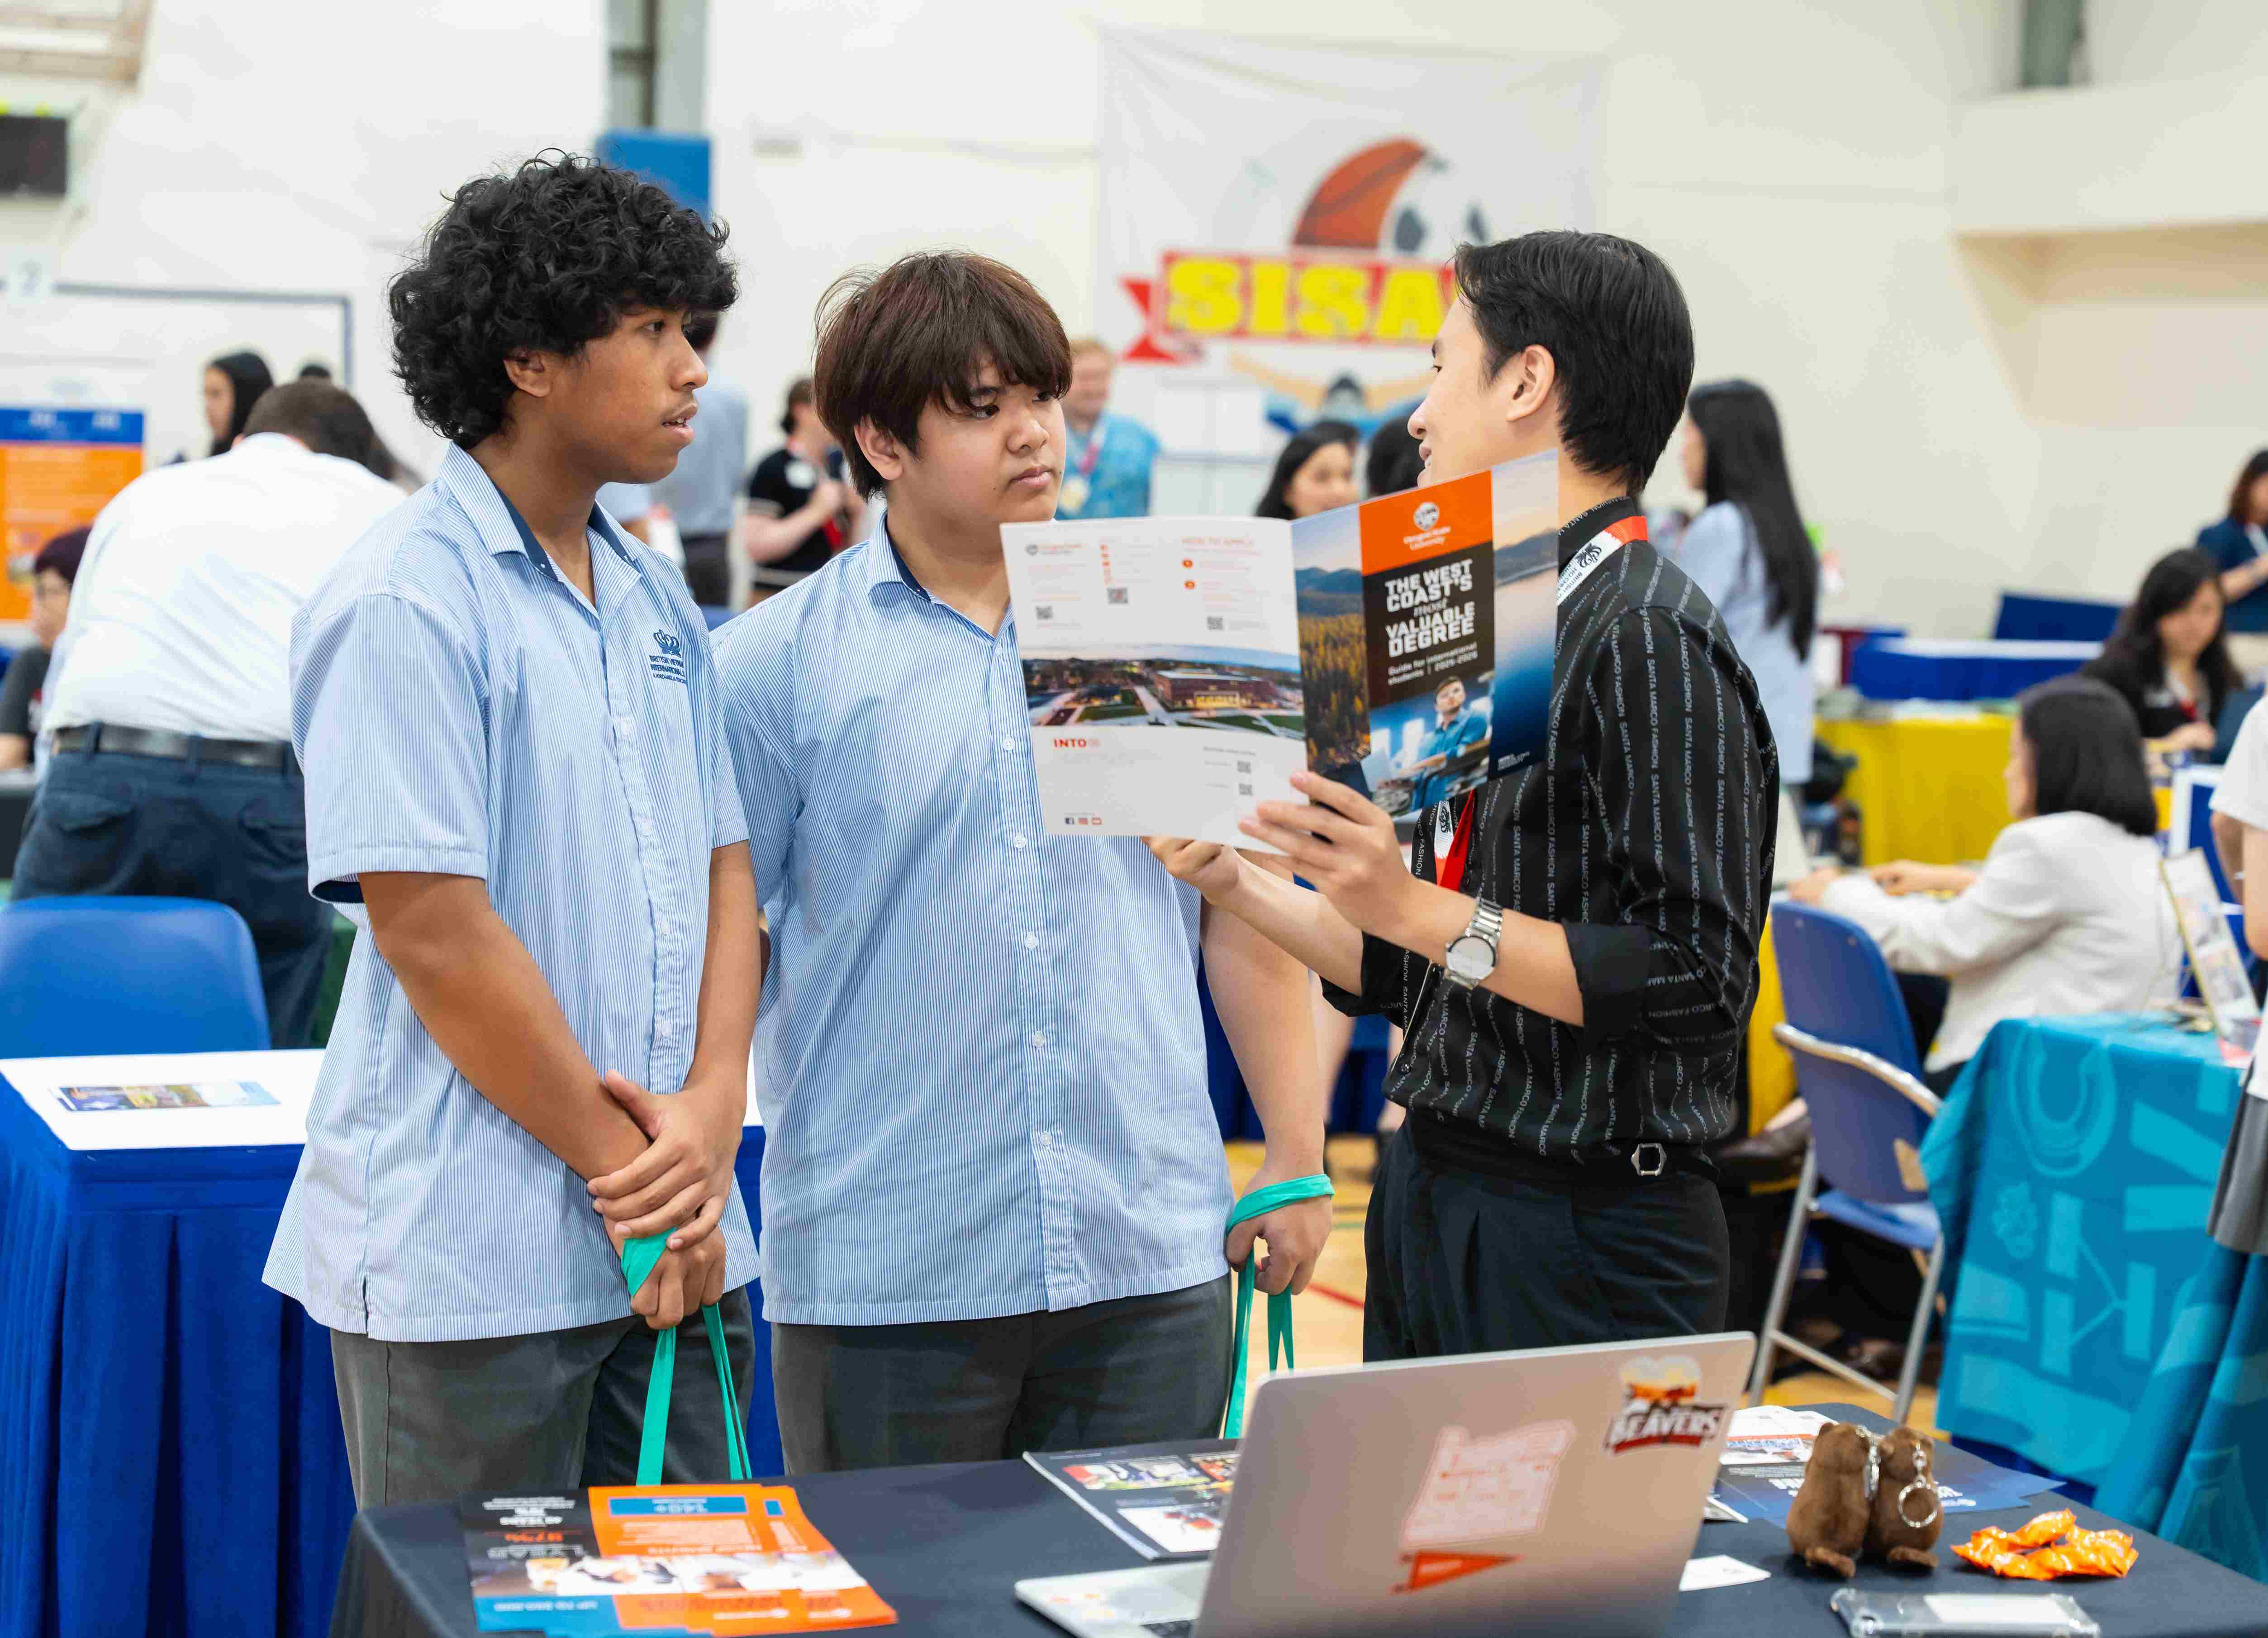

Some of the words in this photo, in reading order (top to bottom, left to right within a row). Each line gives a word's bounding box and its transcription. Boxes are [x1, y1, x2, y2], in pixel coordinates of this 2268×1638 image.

[1166, 256, 1459, 343] SISA
[1385, 573, 1420, 596] THE
[1423, 558, 1473, 584] WEST
[1386, 572, 1474, 612] COAST'S
[1385, 601, 1475, 639] VALUABLE
[1413, 598, 1448, 618] most
[1388, 617, 1474, 657] DEGREE
[1643, 617, 1655, 654] FASHION
[1679, 636, 1690, 670] MARCO
[1388, 661, 1412, 676] Guide
[1646, 659, 1657, 689] SANTA
[1615, 675, 1625, 717] FASHION
[1650, 690, 1658, 726] MARCO
[1683, 671, 1692, 712] FASHION
[1684, 716, 1693, 748] SANTA
[1716, 697, 1725, 732] MARCO
[1053, 738, 1087, 748] INTO
[1620, 722, 1631, 753] SANTA
[1650, 727, 1659, 769] FASHION
[1625, 754, 1634, 790] MARCO
[1684, 749, 1692, 786] MARCO
[1651, 774, 1660, 805] SANTA
[1685, 787, 1694, 828] FASHION
[1653, 806, 1663, 842] MARCO
[1716, 812, 1724, 848] MARCO
[1415, 838, 1425, 876] FASHION
[1688, 832, 1697, 862] SANTA
[1547, 882, 1555, 913] SANTA
[1691, 864, 1700, 900] MARCO
[1439, 1003, 1448, 1035] MARCO
[1439, 1038, 1448, 1076] FASHION
[1465, 1031, 1478, 1057] SANTA
[1494, 1050, 1506, 1085] FASHION
[1553, 1061, 1562, 1100] FASHION
[1482, 1087, 1497, 1114] SANTA
[1520, 1075, 1533, 1107] MARCO
[1581, 1078, 1589, 1111] MARCO
[1539, 1124, 1549, 1156] MARCO
